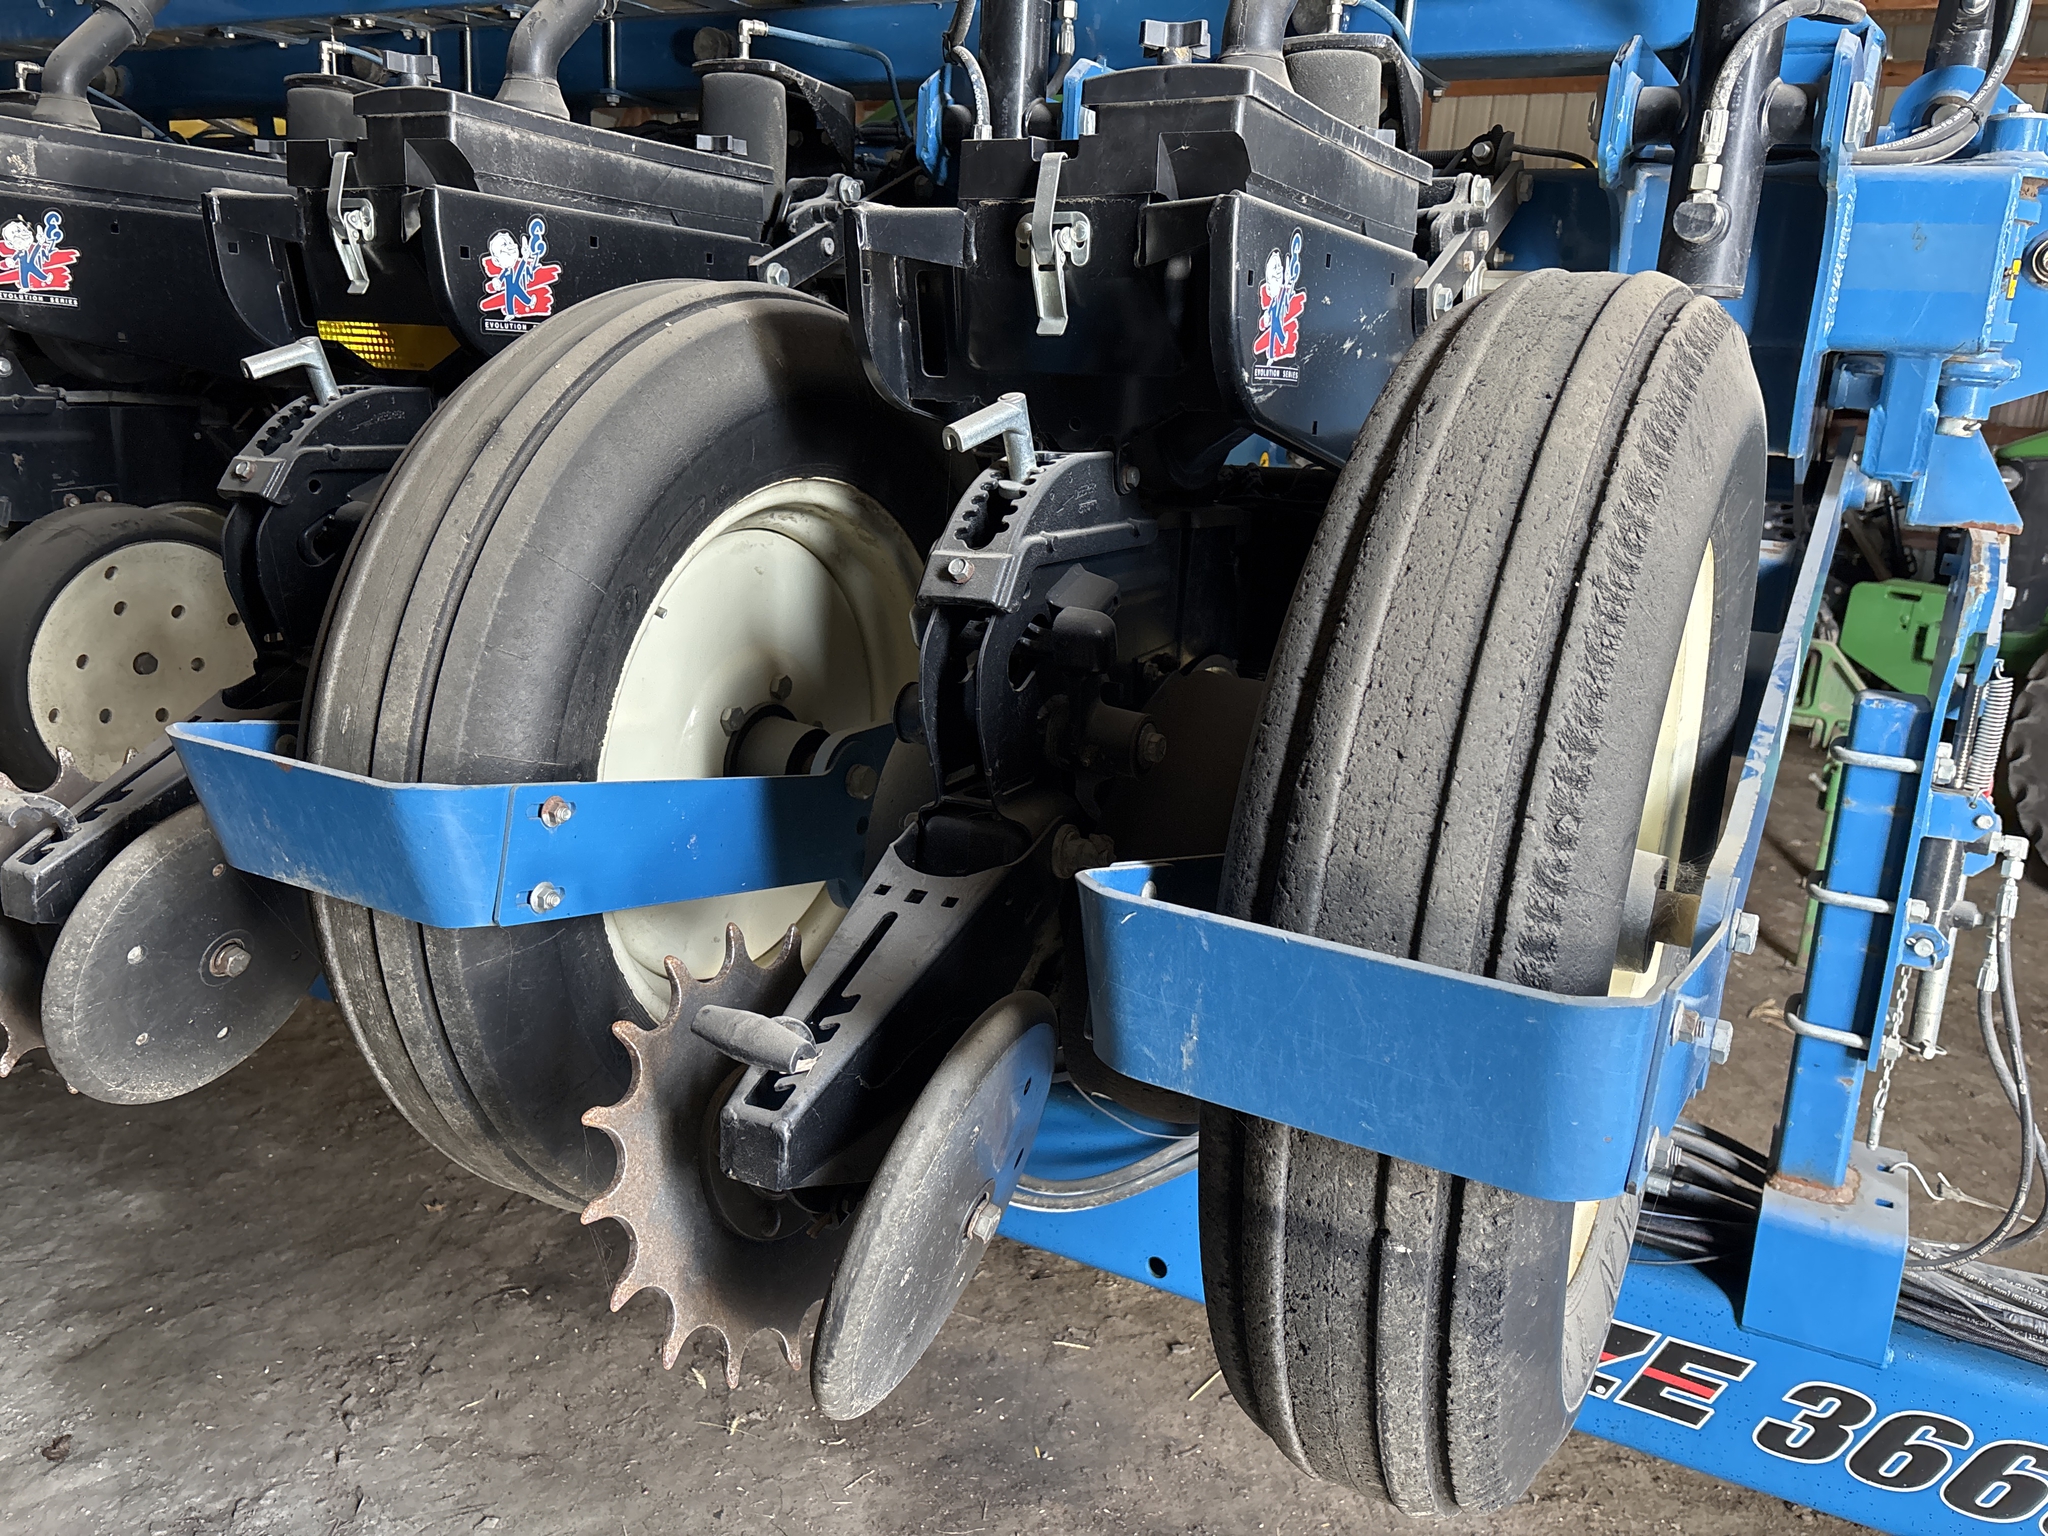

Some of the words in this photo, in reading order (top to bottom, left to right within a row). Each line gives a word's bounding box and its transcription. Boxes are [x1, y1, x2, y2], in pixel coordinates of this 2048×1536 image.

[49, 297, 79, 306] SERIES
[484, 321, 528, 331] EVOLUTION
[1254, 367, 1281, 378] EVOLUTION
[1282, 369, 1299, 380] SERIES
[1752, 1380, 2048, 1536] 366
